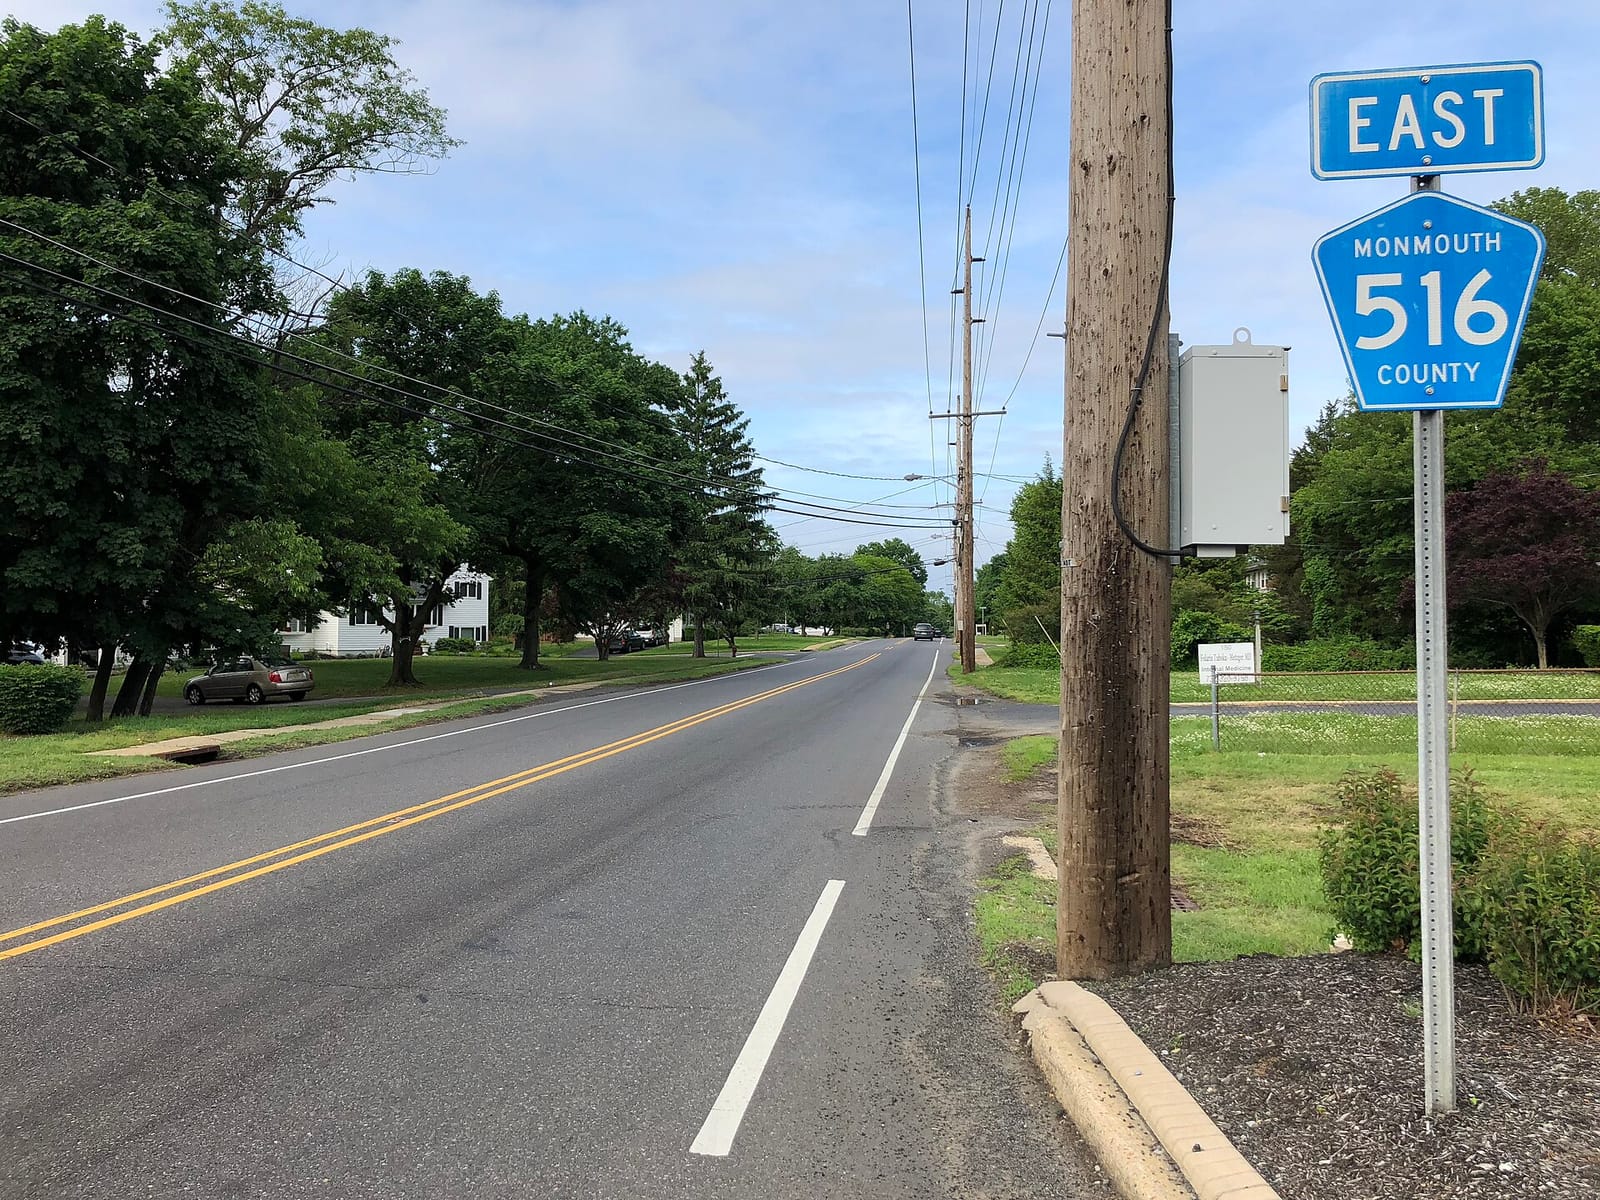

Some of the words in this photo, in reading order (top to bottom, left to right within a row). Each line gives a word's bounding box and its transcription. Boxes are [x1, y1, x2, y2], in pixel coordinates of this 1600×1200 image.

[1348, 88, 1504, 153] EAST
[1354, 231, 1502, 258] MONMOUTH
[1355, 268, 1509, 350] 516
[1377, 361, 1481, 386] COUNTY
